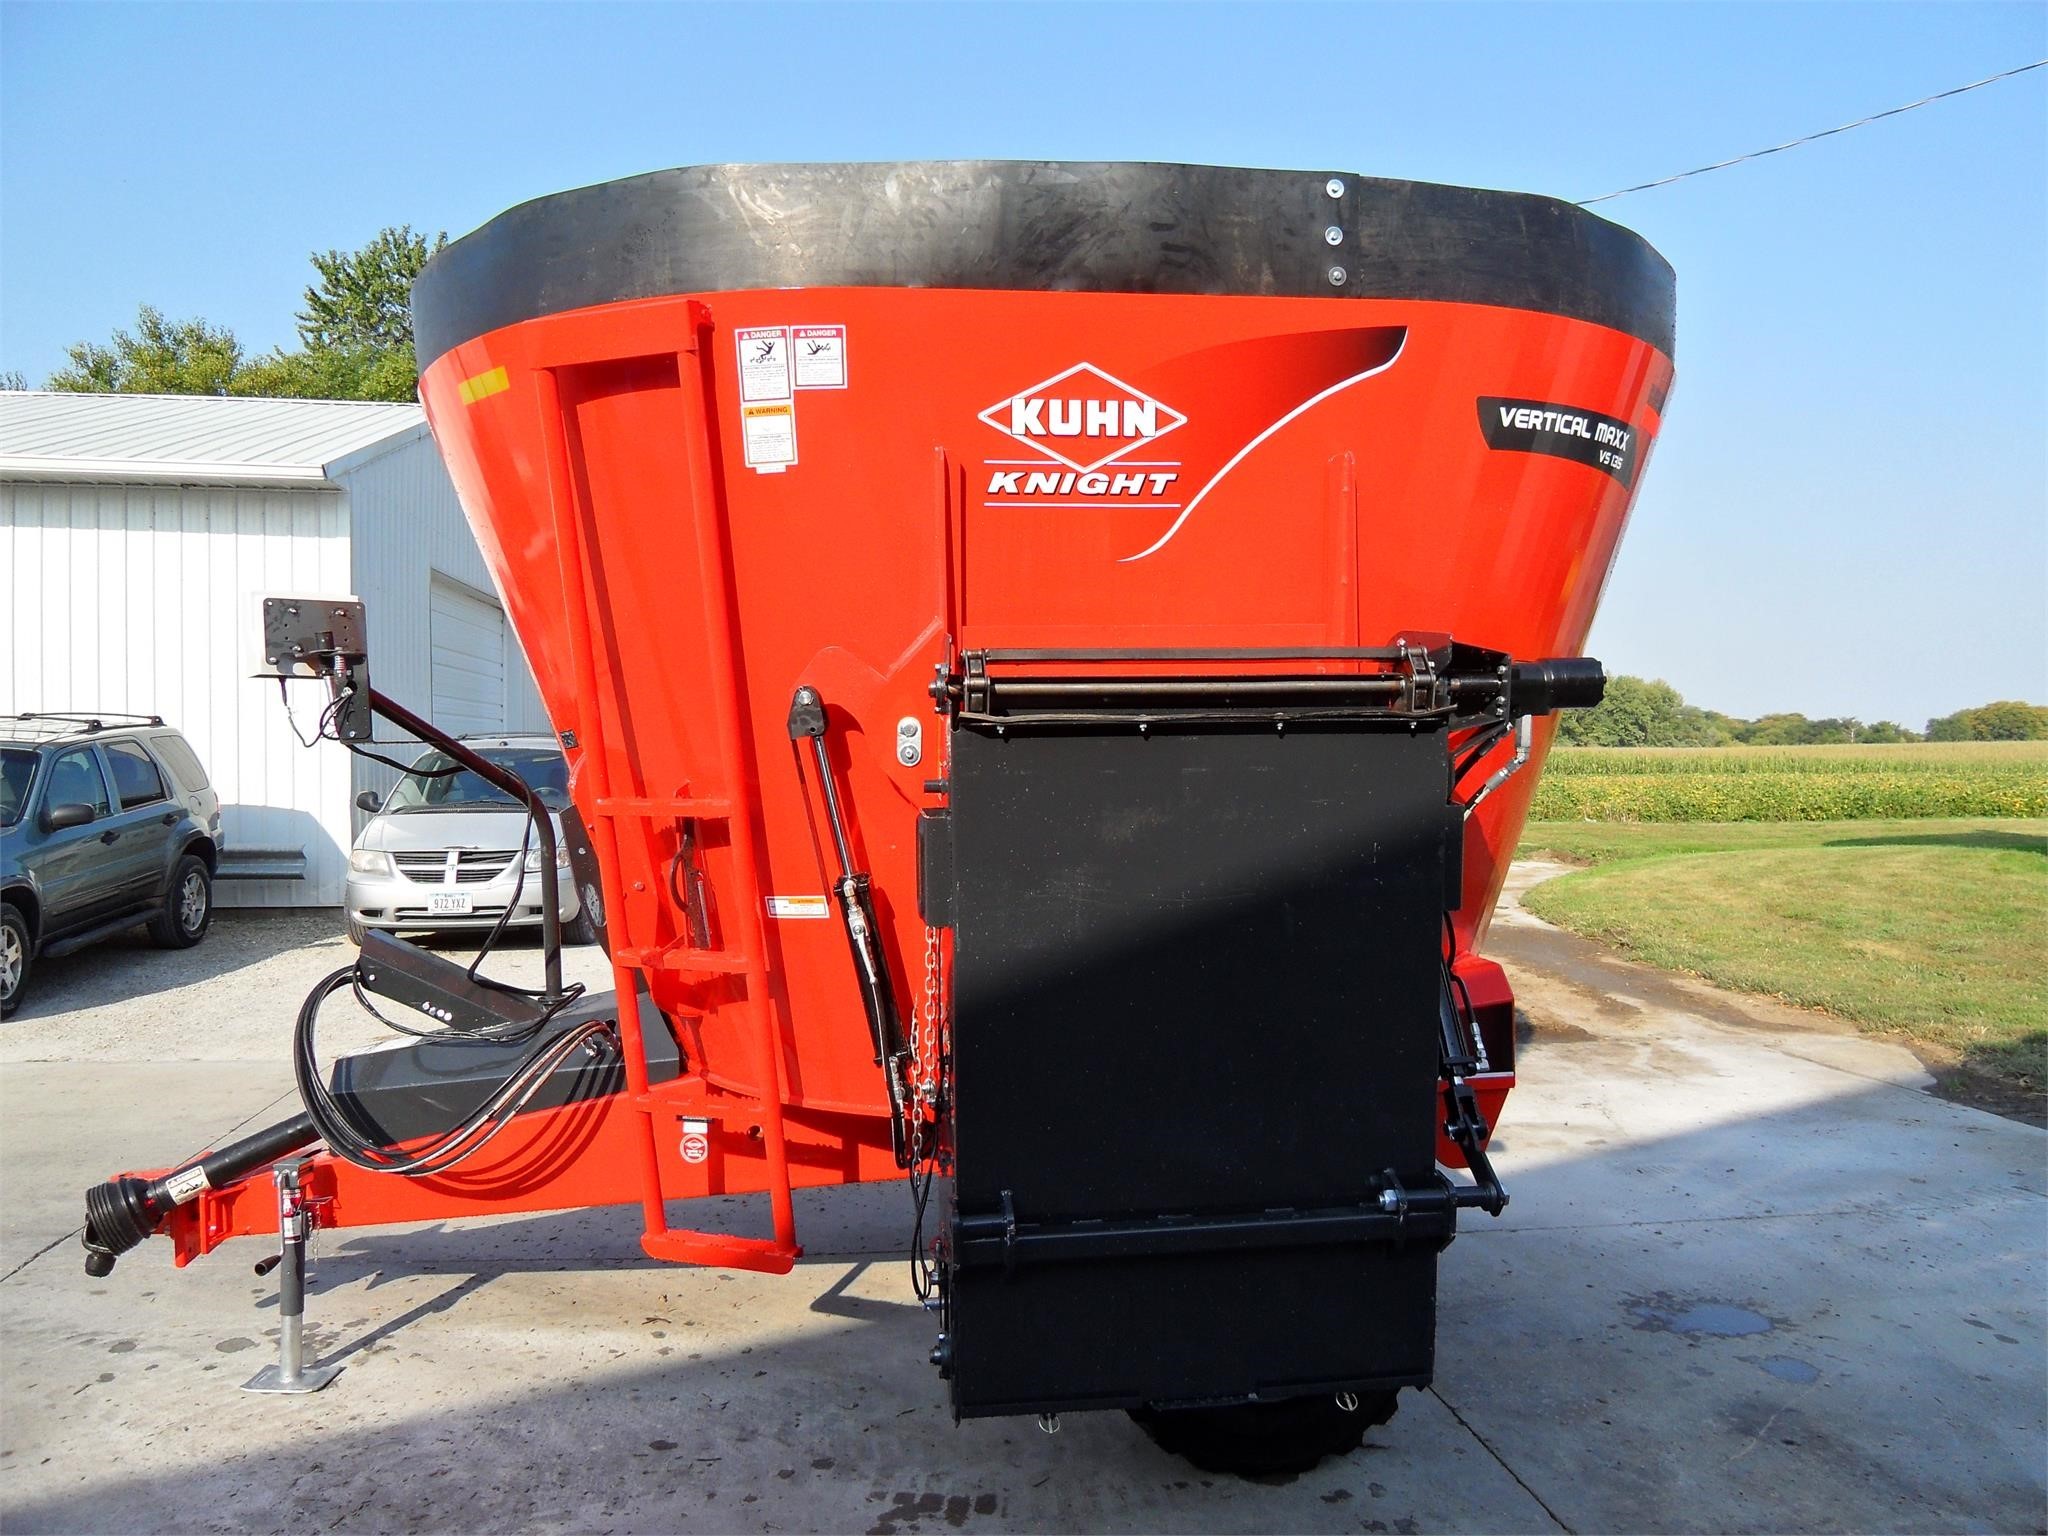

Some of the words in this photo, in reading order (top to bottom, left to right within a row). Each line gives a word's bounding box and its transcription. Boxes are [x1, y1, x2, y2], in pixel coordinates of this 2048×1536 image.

[751, 330, 783, 339] DANGER
[807, 329, 837, 337] DANGER
[1011, 398, 1156, 437] KUHN
[1500, 406, 1591, 439] VERTICAL
[1594, 422, 1630, 451] MAXX
[1599, 449, 1611, 465] VS
[987, 471, 1178, 495] KNIGHT
[434, 898, 448, 908] 972
[451, 898, 465, 908] YXZ
